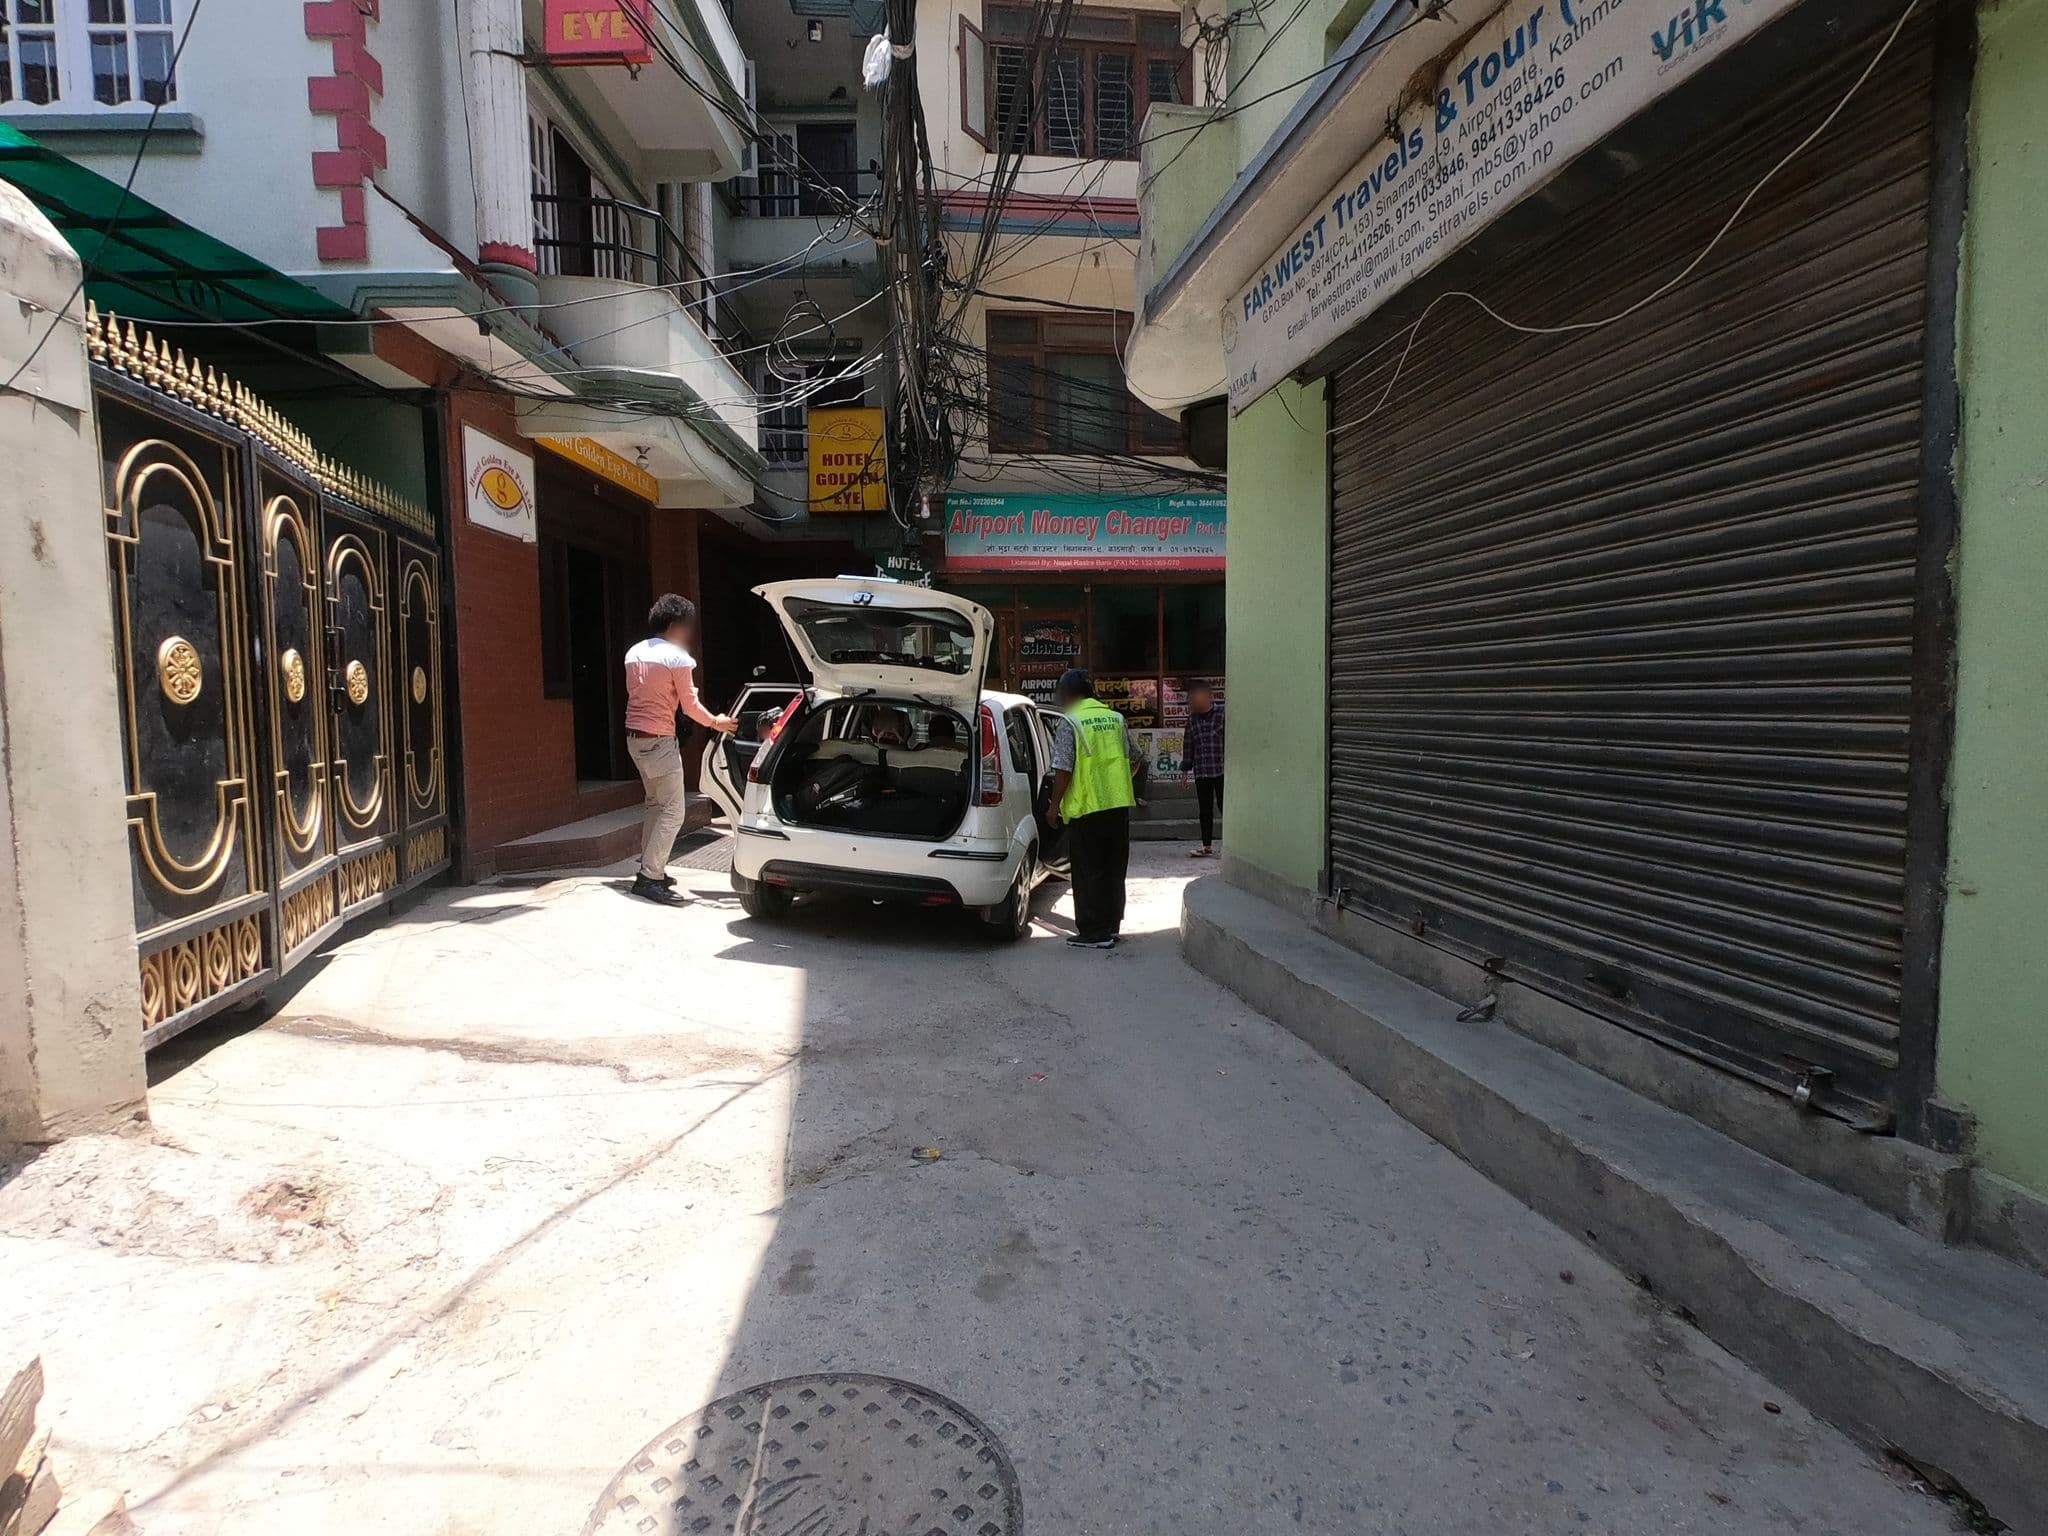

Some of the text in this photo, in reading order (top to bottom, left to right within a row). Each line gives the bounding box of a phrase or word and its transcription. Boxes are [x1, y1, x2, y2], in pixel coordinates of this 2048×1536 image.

[562, 10, 630, 40] EYE
[1458, 62, 1544, 144] Airportgate,
[1471, 66, 1566, 158] 9841338426
[1242, 4, 1545, 323] FAR-WEST Travels & Tour
[1373, 140, 1554, 291] www.farwesttravels.com.np
[481, 454, 502, 467] Golden
[575, 437, 605, 469] Golden
[949, 509, 1025, 541] Airport
[1031, 509, 1100, 542] Money
[1105, 509, 1192, 542] Changer
[887, 555, 923, 572] HOTEL
[1020, 643, 1081, 656] CHANGER
[1021, 679, 1058, 690] AIRPORT
